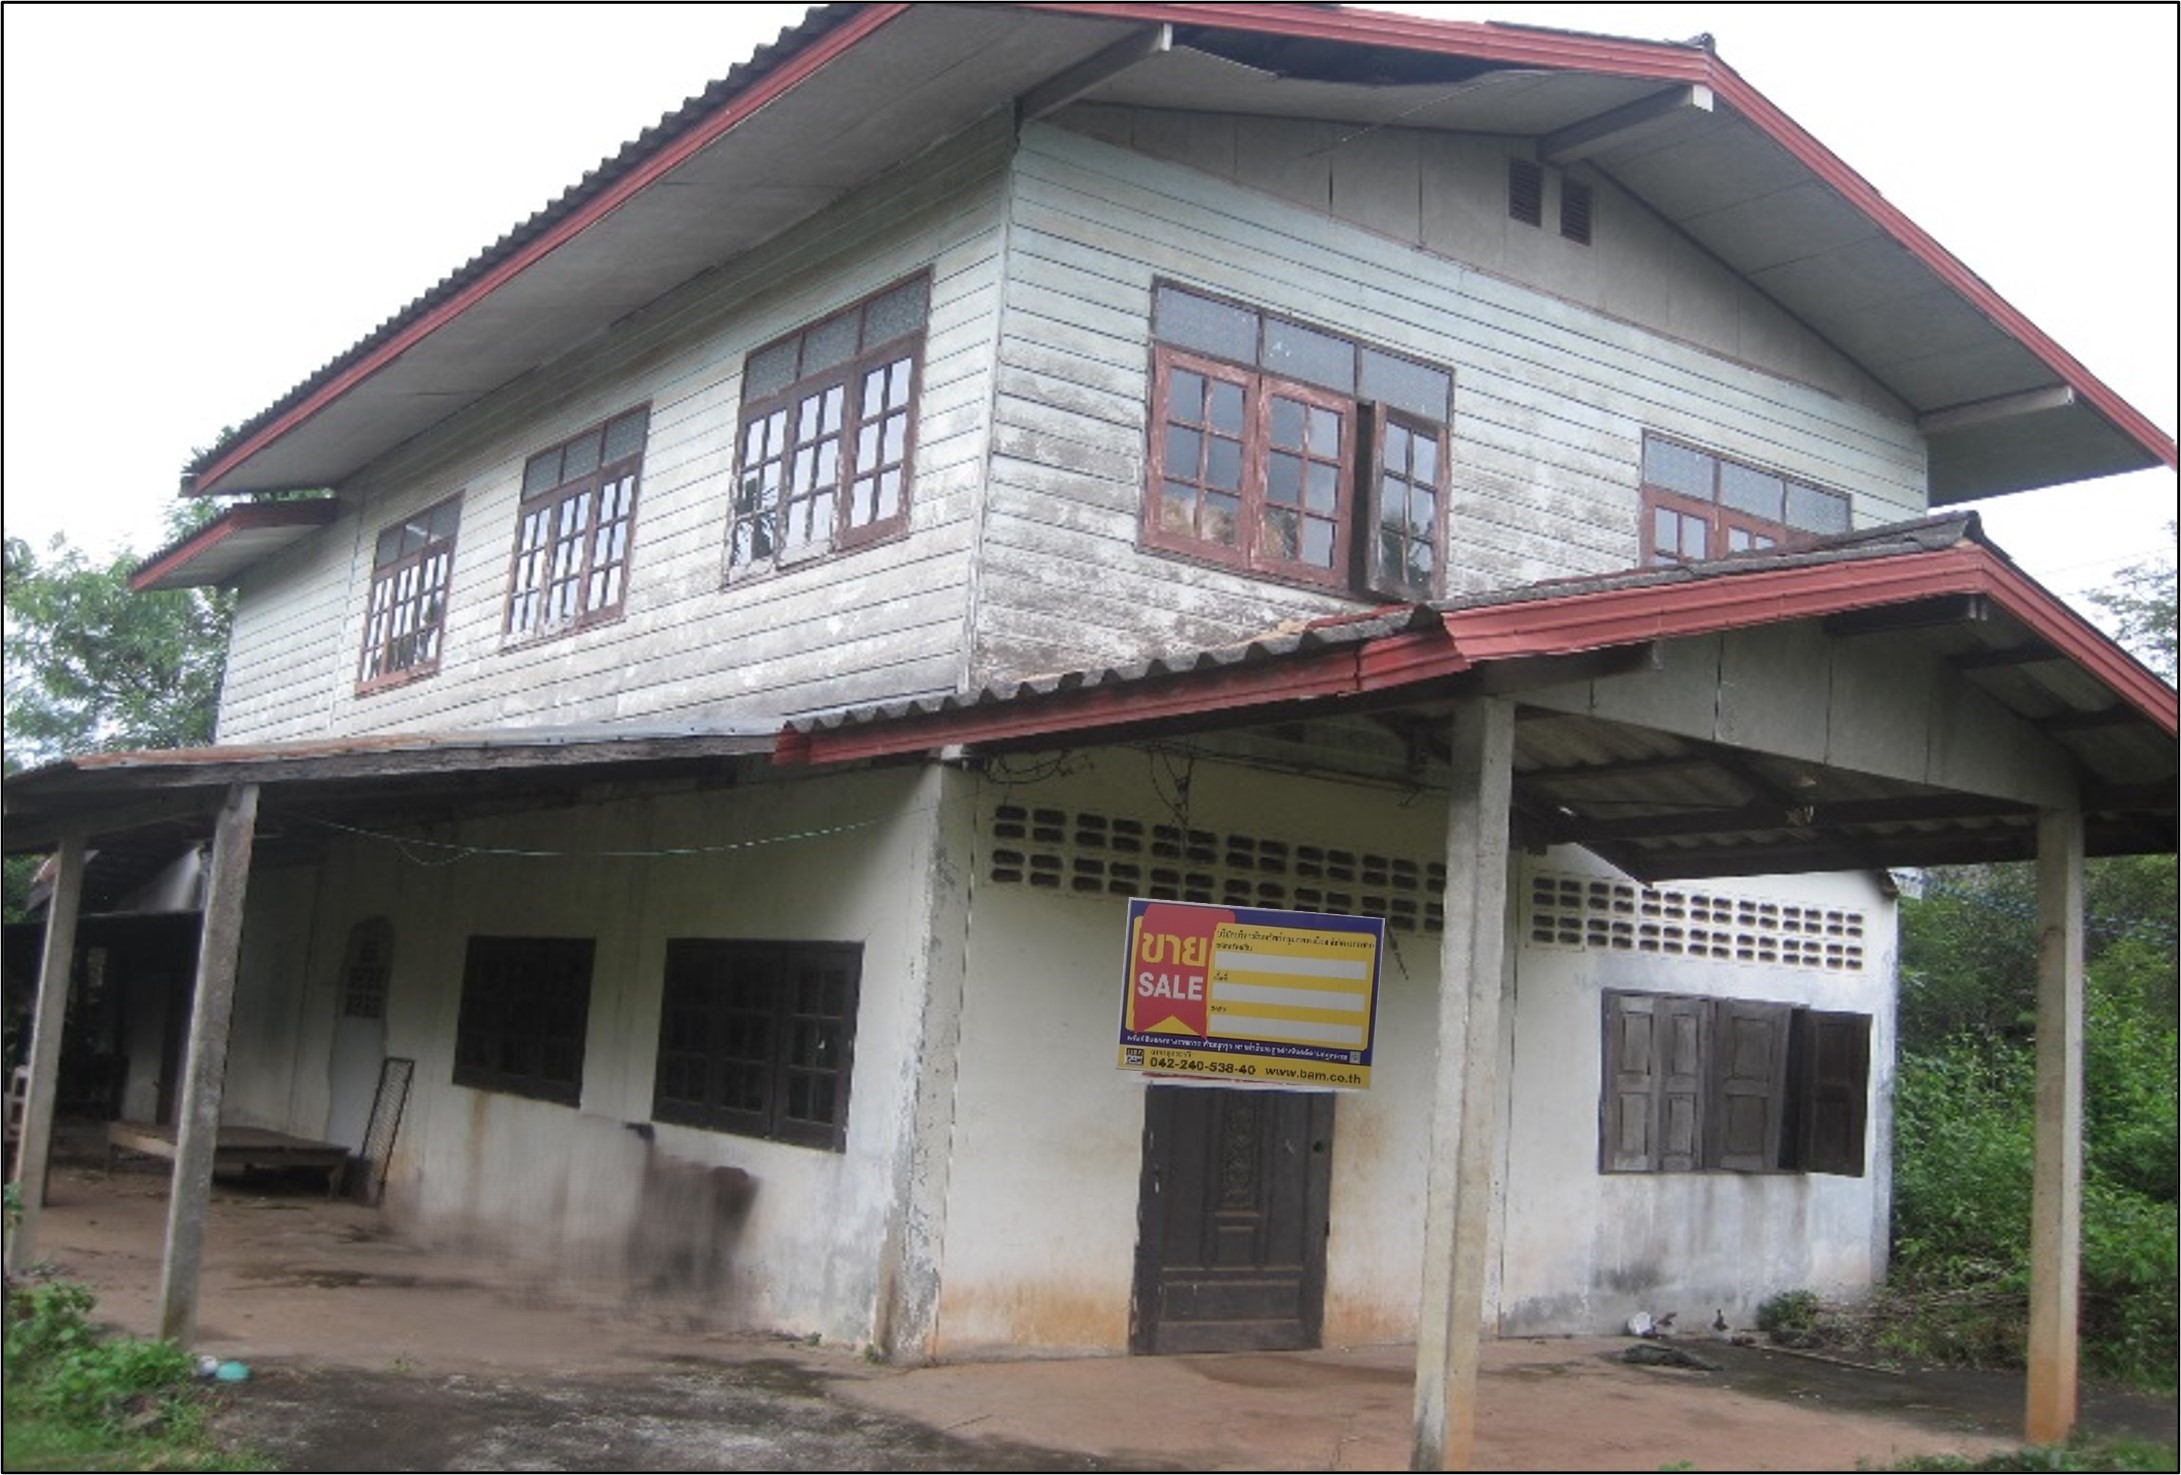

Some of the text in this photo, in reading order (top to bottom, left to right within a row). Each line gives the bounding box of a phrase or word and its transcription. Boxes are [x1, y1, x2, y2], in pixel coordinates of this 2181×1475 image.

[1141, 932, 1208, 967] ขาย
[1137, 971, 1204, 1001] SALE
[1150, 1057, 1361, 1085] 042-240-538-40 www.bam.co.th
